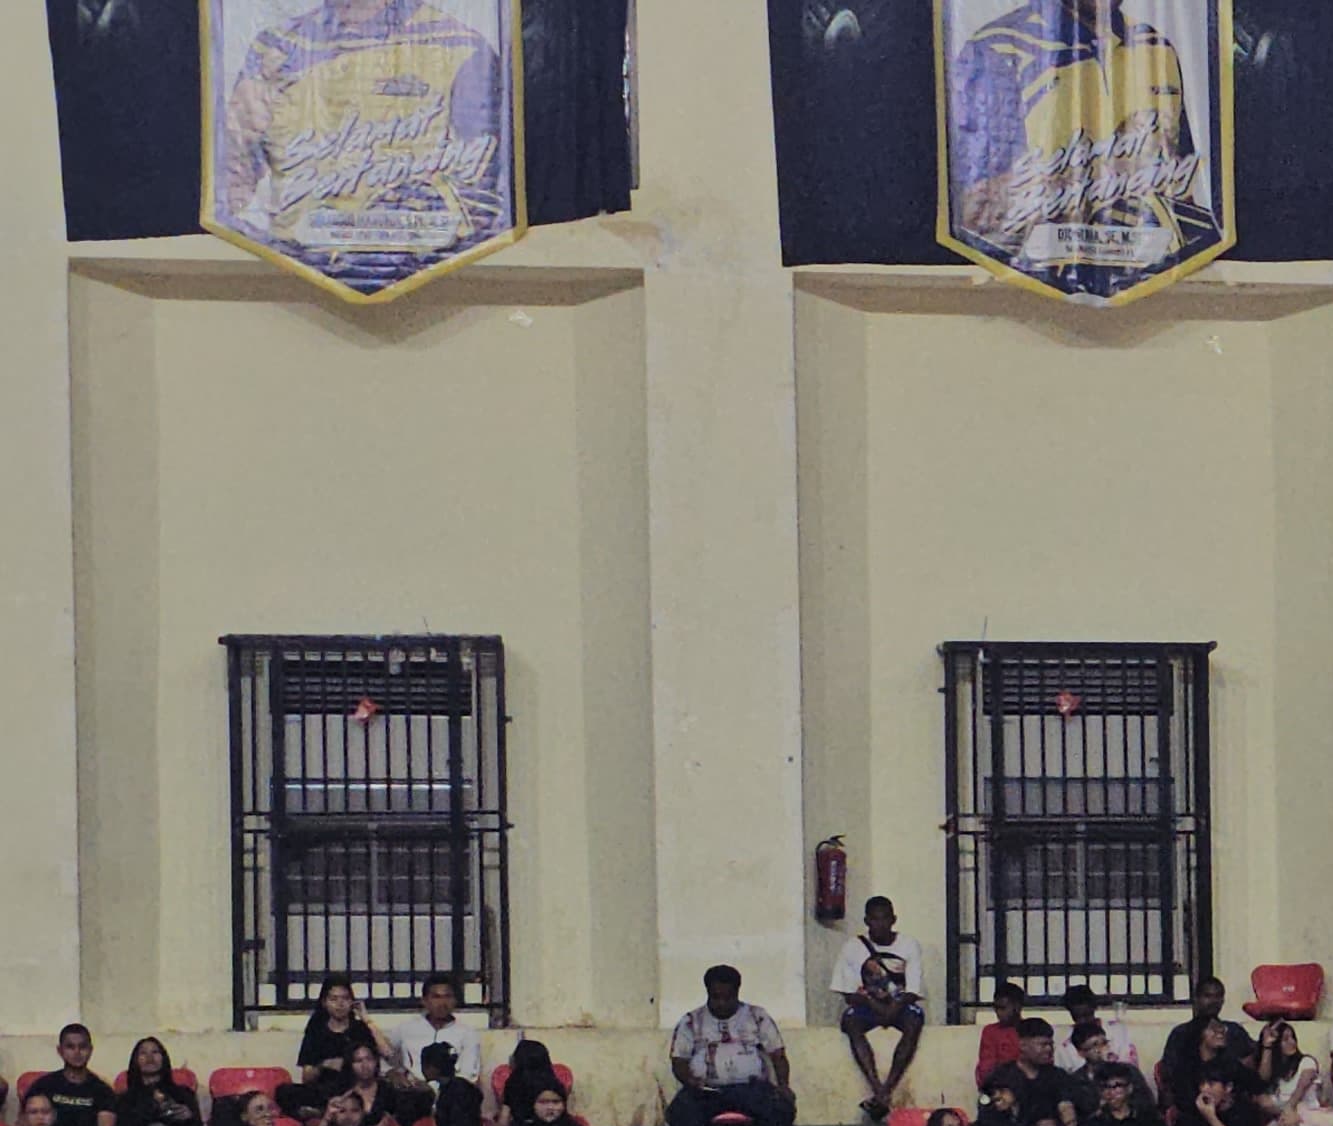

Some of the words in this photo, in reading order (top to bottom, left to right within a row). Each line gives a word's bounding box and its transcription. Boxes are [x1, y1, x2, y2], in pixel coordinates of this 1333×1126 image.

[279, 127, 499, 212] Bertanding
[281, 95, 445, 172] Selamat
[1008, 110, 1160, 189] Selamat
[1003, 147, 1200, 233] Bertanding
